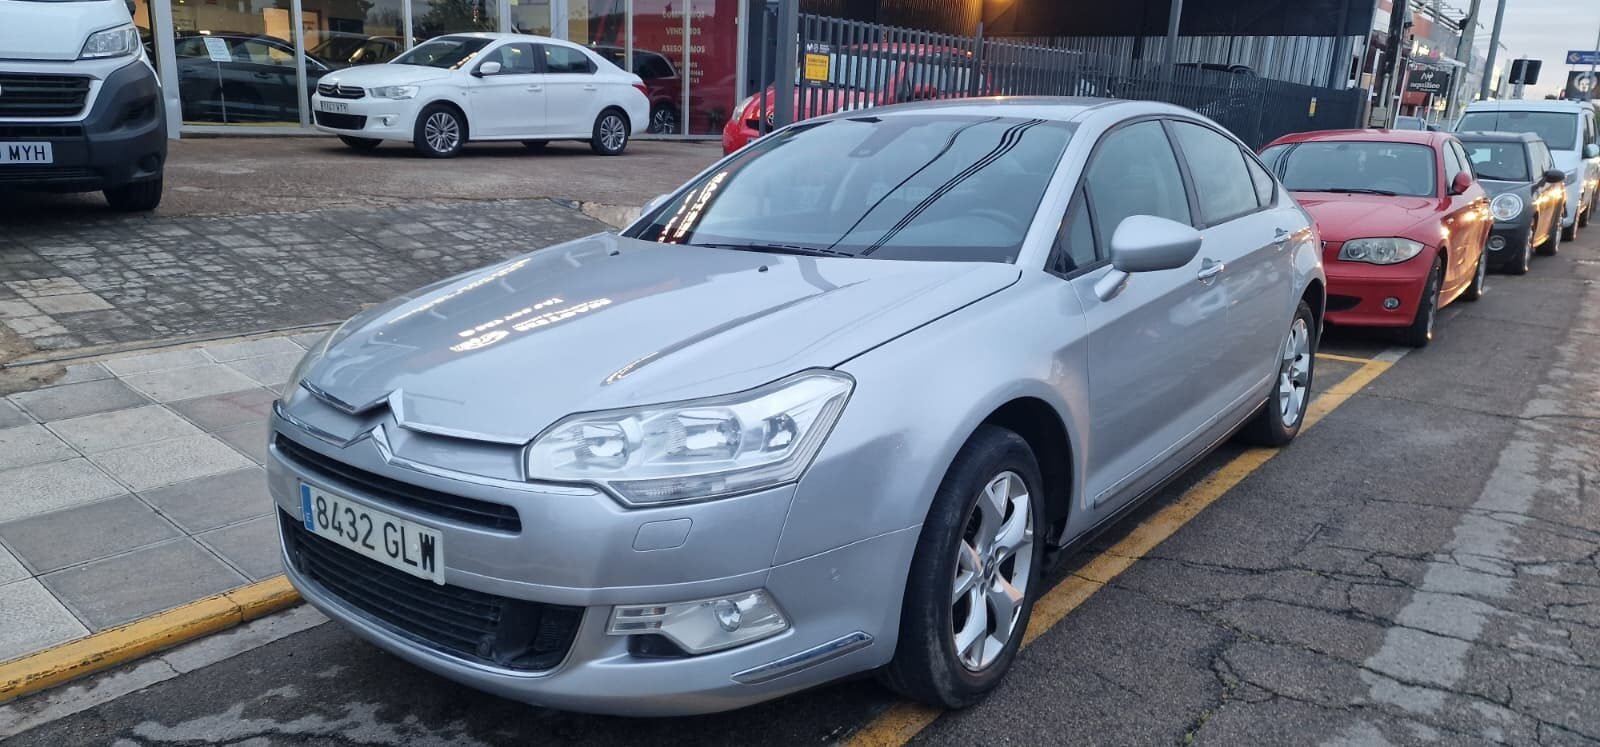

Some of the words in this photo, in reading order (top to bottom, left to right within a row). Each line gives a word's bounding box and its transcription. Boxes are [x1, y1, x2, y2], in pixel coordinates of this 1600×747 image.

[665, 27, 701, 35] VENDOS
[661, 45, 705, 53] ASESOMOS
[9, 145, 45, 160] MYH
[316, 496, 375, 550] 8432
[384, 522, 435, 573] GLW
